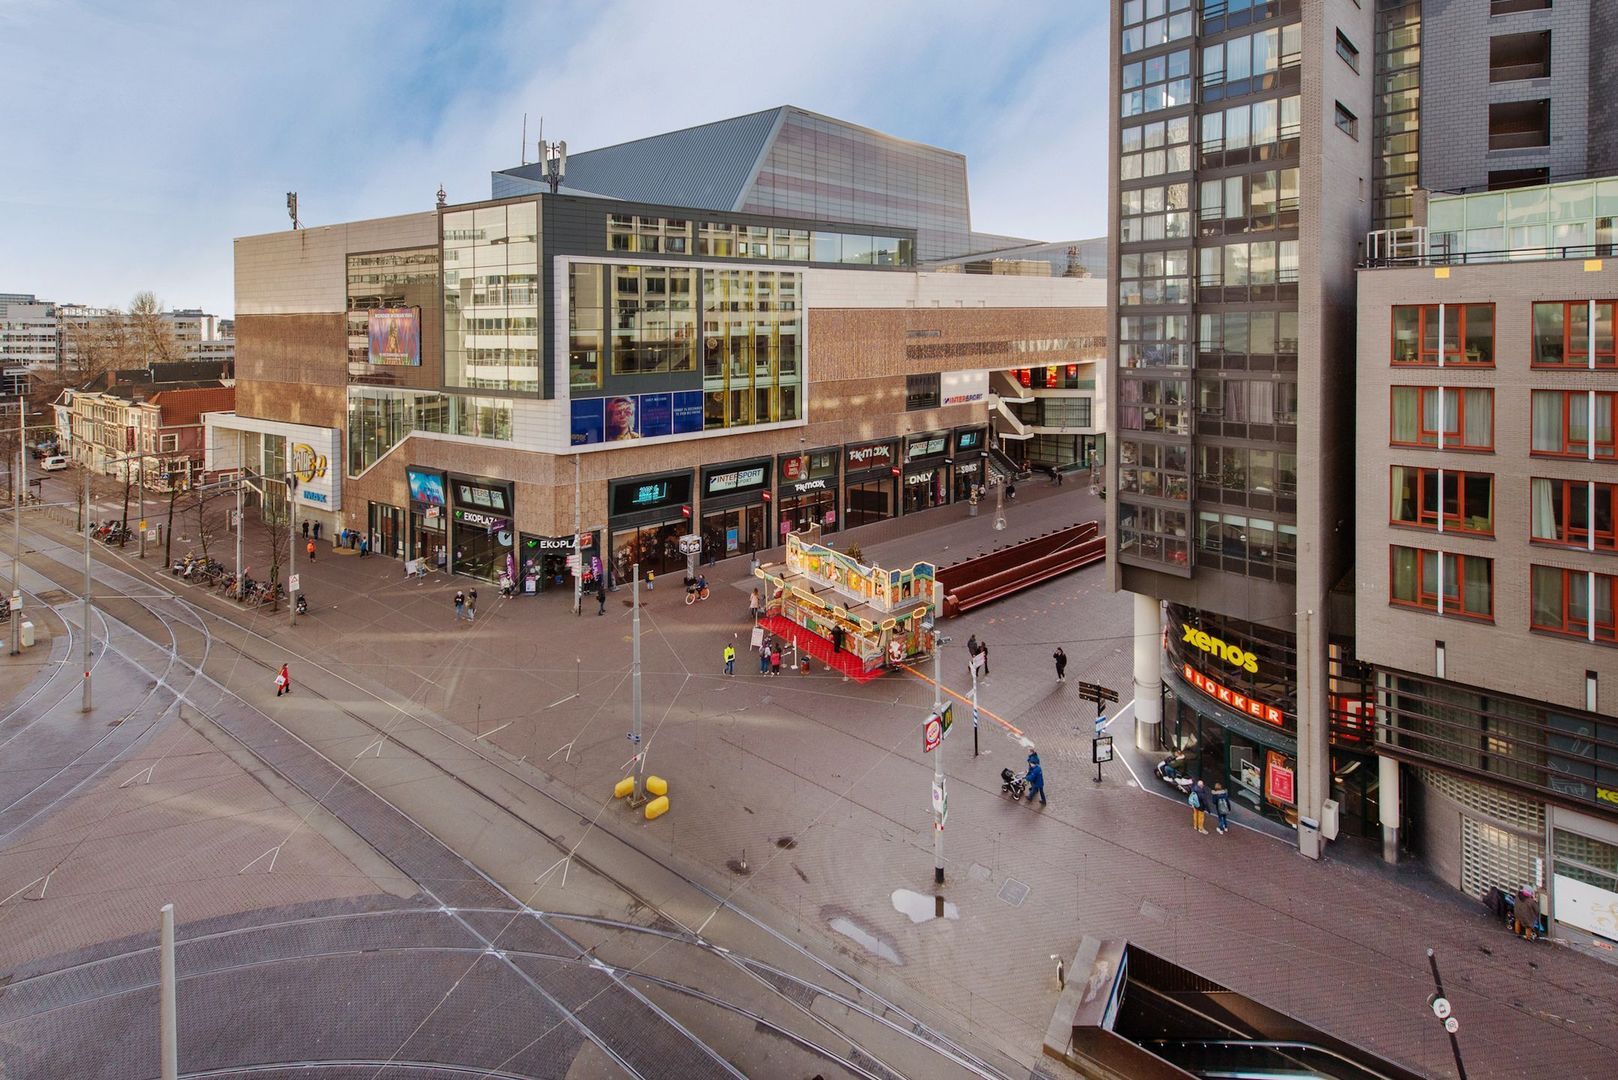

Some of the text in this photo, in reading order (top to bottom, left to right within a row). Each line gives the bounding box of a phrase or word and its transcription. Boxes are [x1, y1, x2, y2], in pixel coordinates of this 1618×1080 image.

[949, 394, 983, 404] INTERSPORT
[717, 470, 761, 483] INTERSPORT
[909, 472, 933, 484] ONLY
[540, 540, 577, 549] EKOPLA
[1182, 623, 1259, 673] xenos
[1185, 667, 1279, 722] BLOKKER
